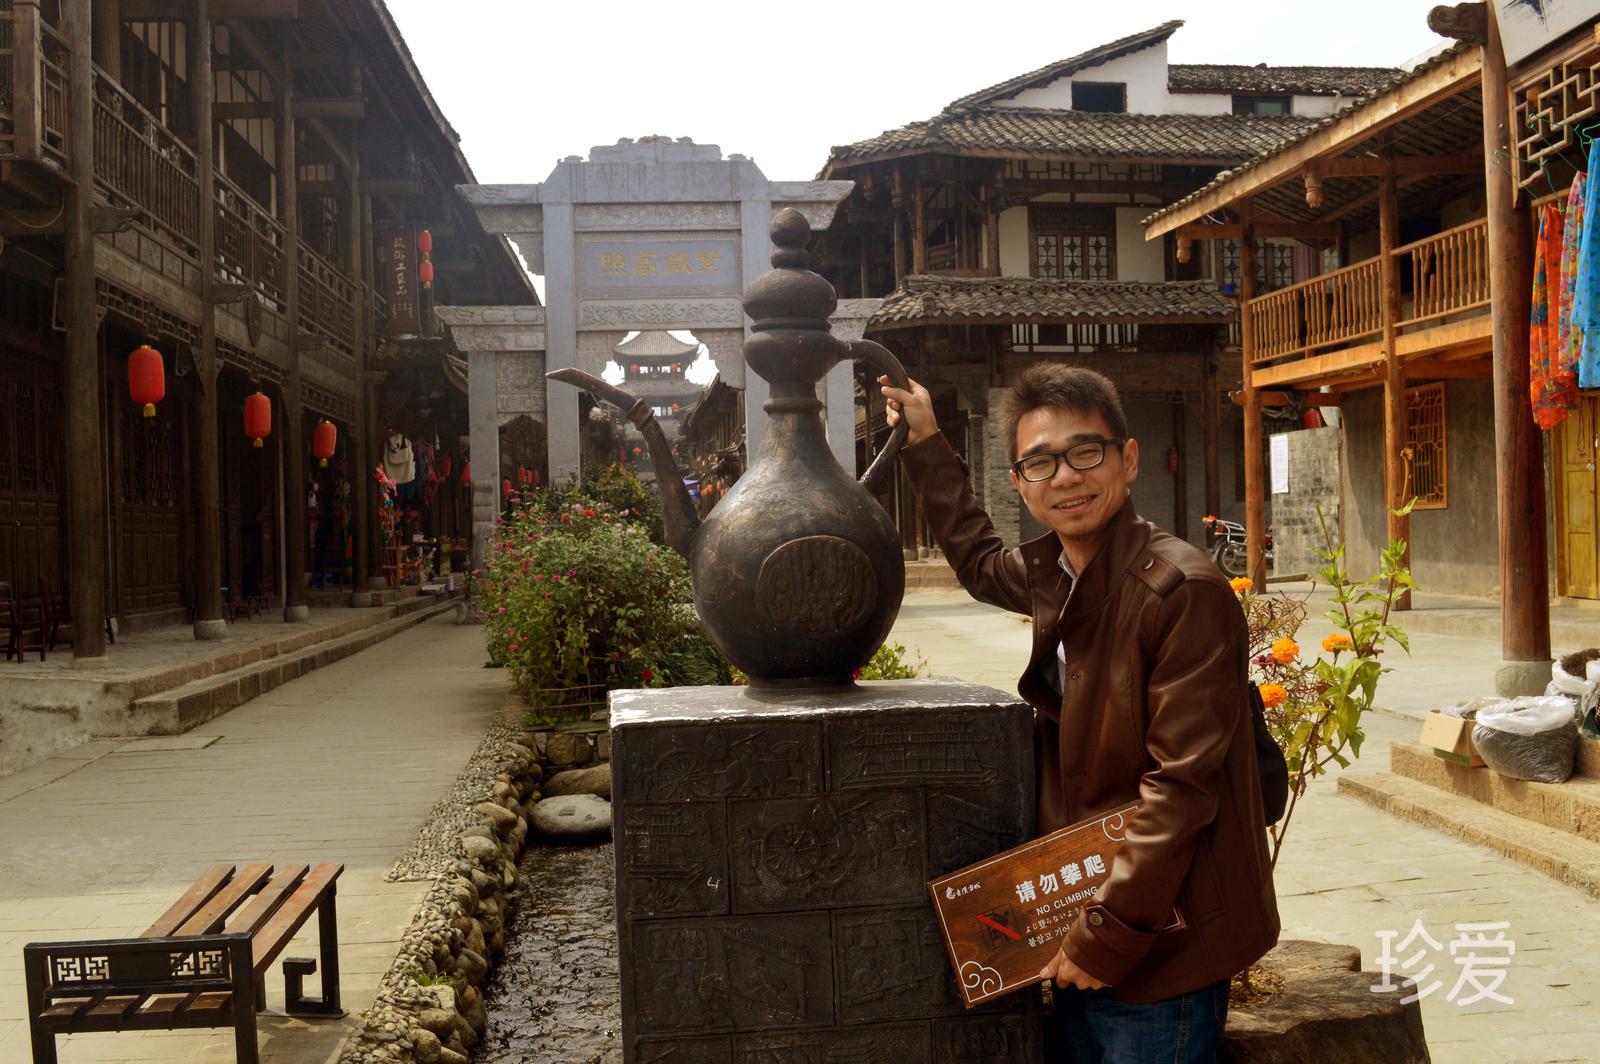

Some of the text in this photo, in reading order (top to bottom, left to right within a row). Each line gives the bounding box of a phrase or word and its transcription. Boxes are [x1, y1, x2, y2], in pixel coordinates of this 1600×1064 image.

[1015, 853, 1106, 904] 请勿攀爬
[1036, 886, 1098, 916] NO CLIMBING
